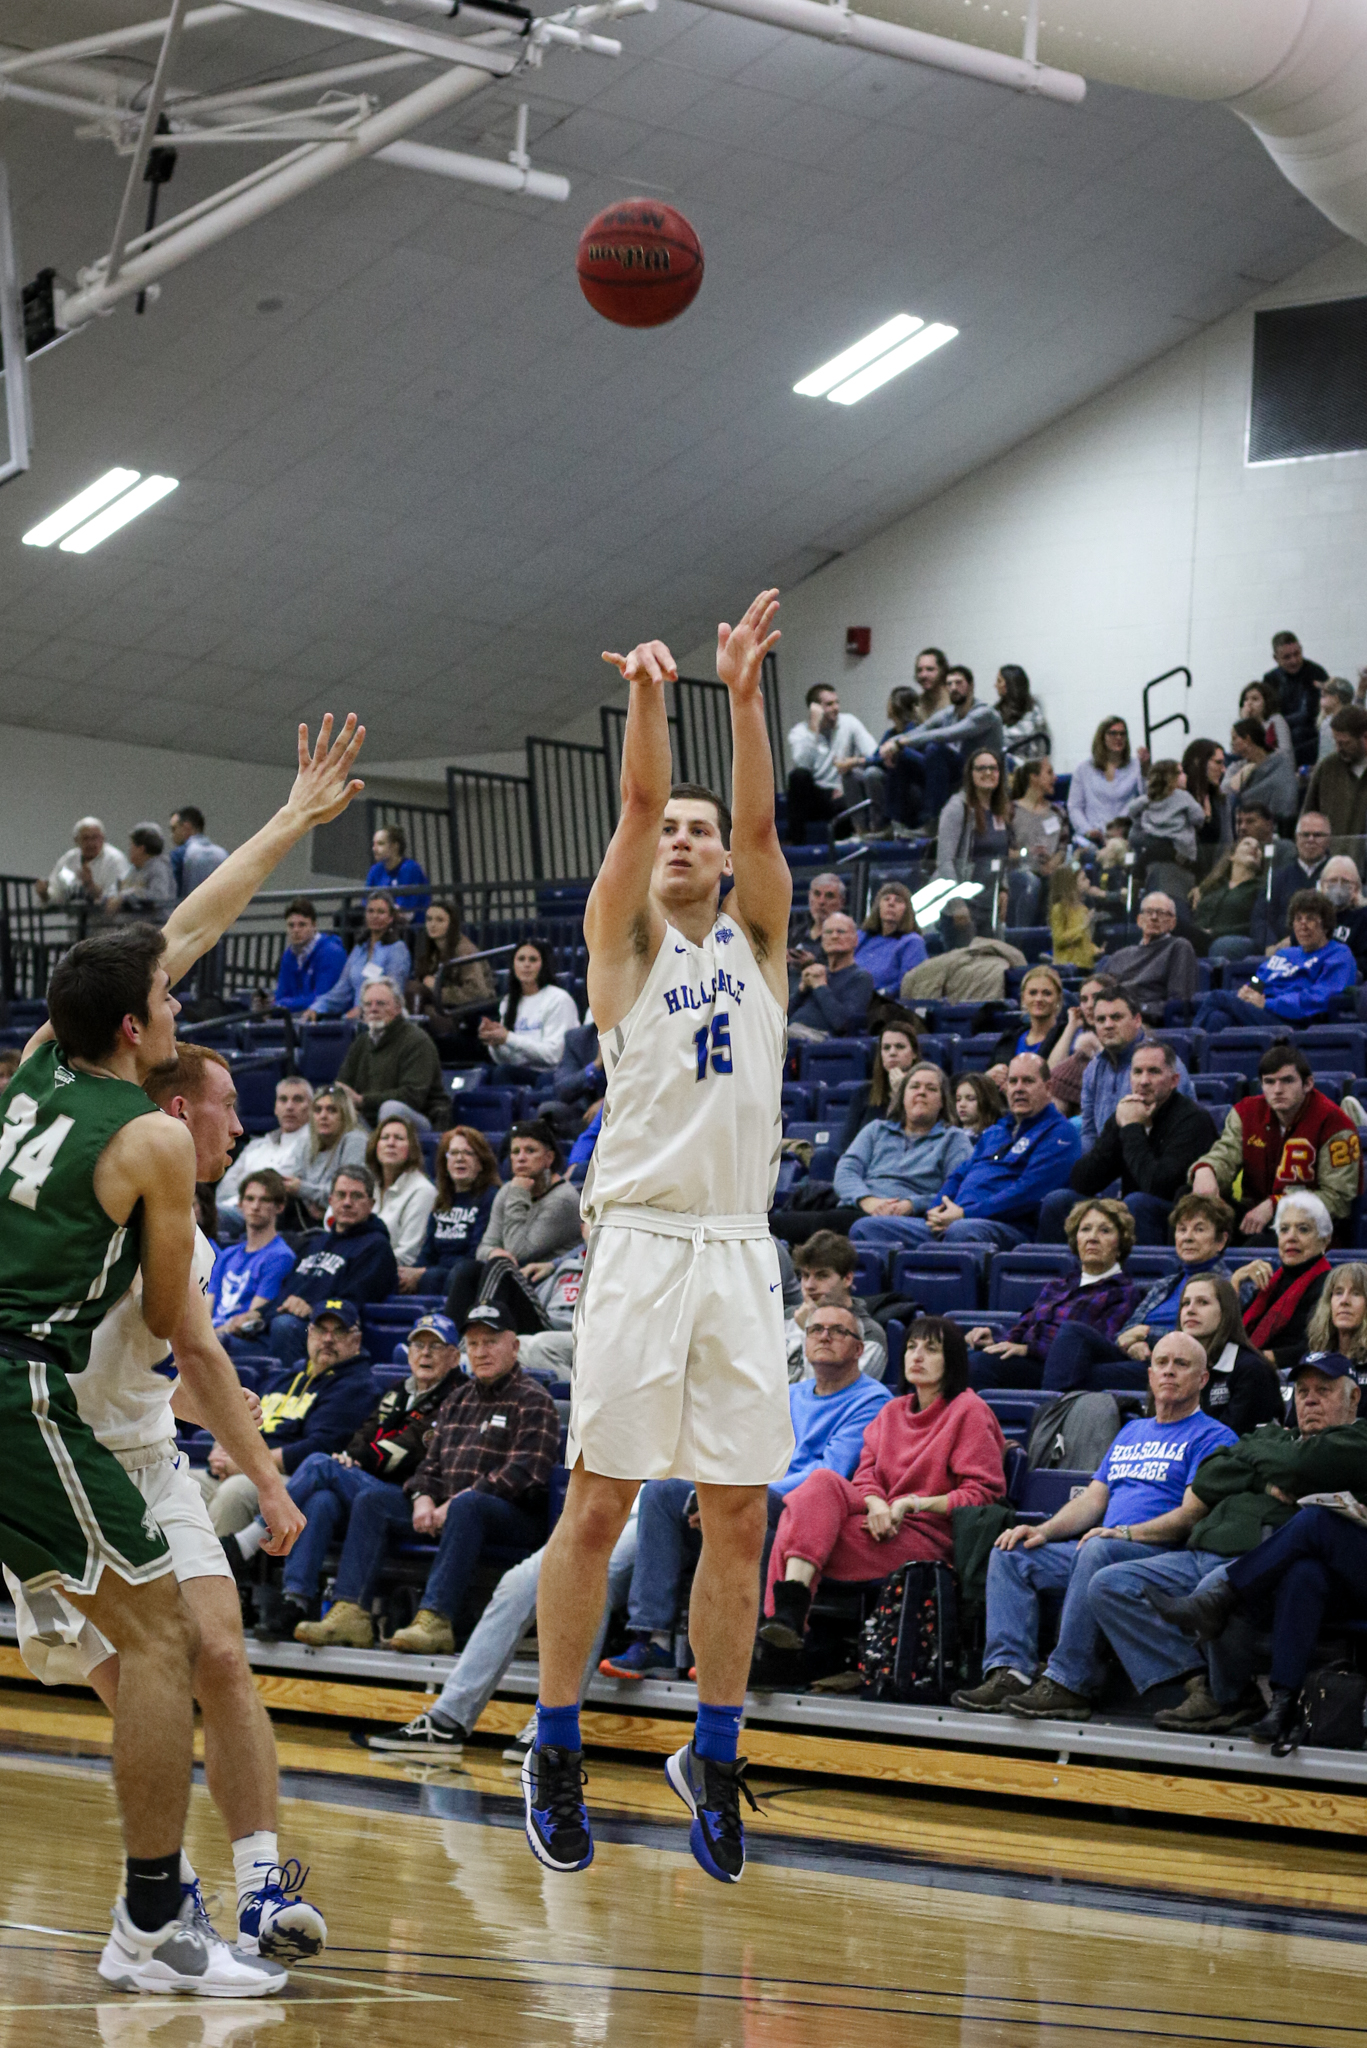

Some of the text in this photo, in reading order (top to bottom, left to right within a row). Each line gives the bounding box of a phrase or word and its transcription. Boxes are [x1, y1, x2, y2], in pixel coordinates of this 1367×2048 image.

[692, 1011, 733, 1083] 15
[1276, 1138, 1317, 1182] R
[1109, 1441, 1188, 1462] HILLSDALE
[1107, 1461, 1170, 1482] COLLEGE
